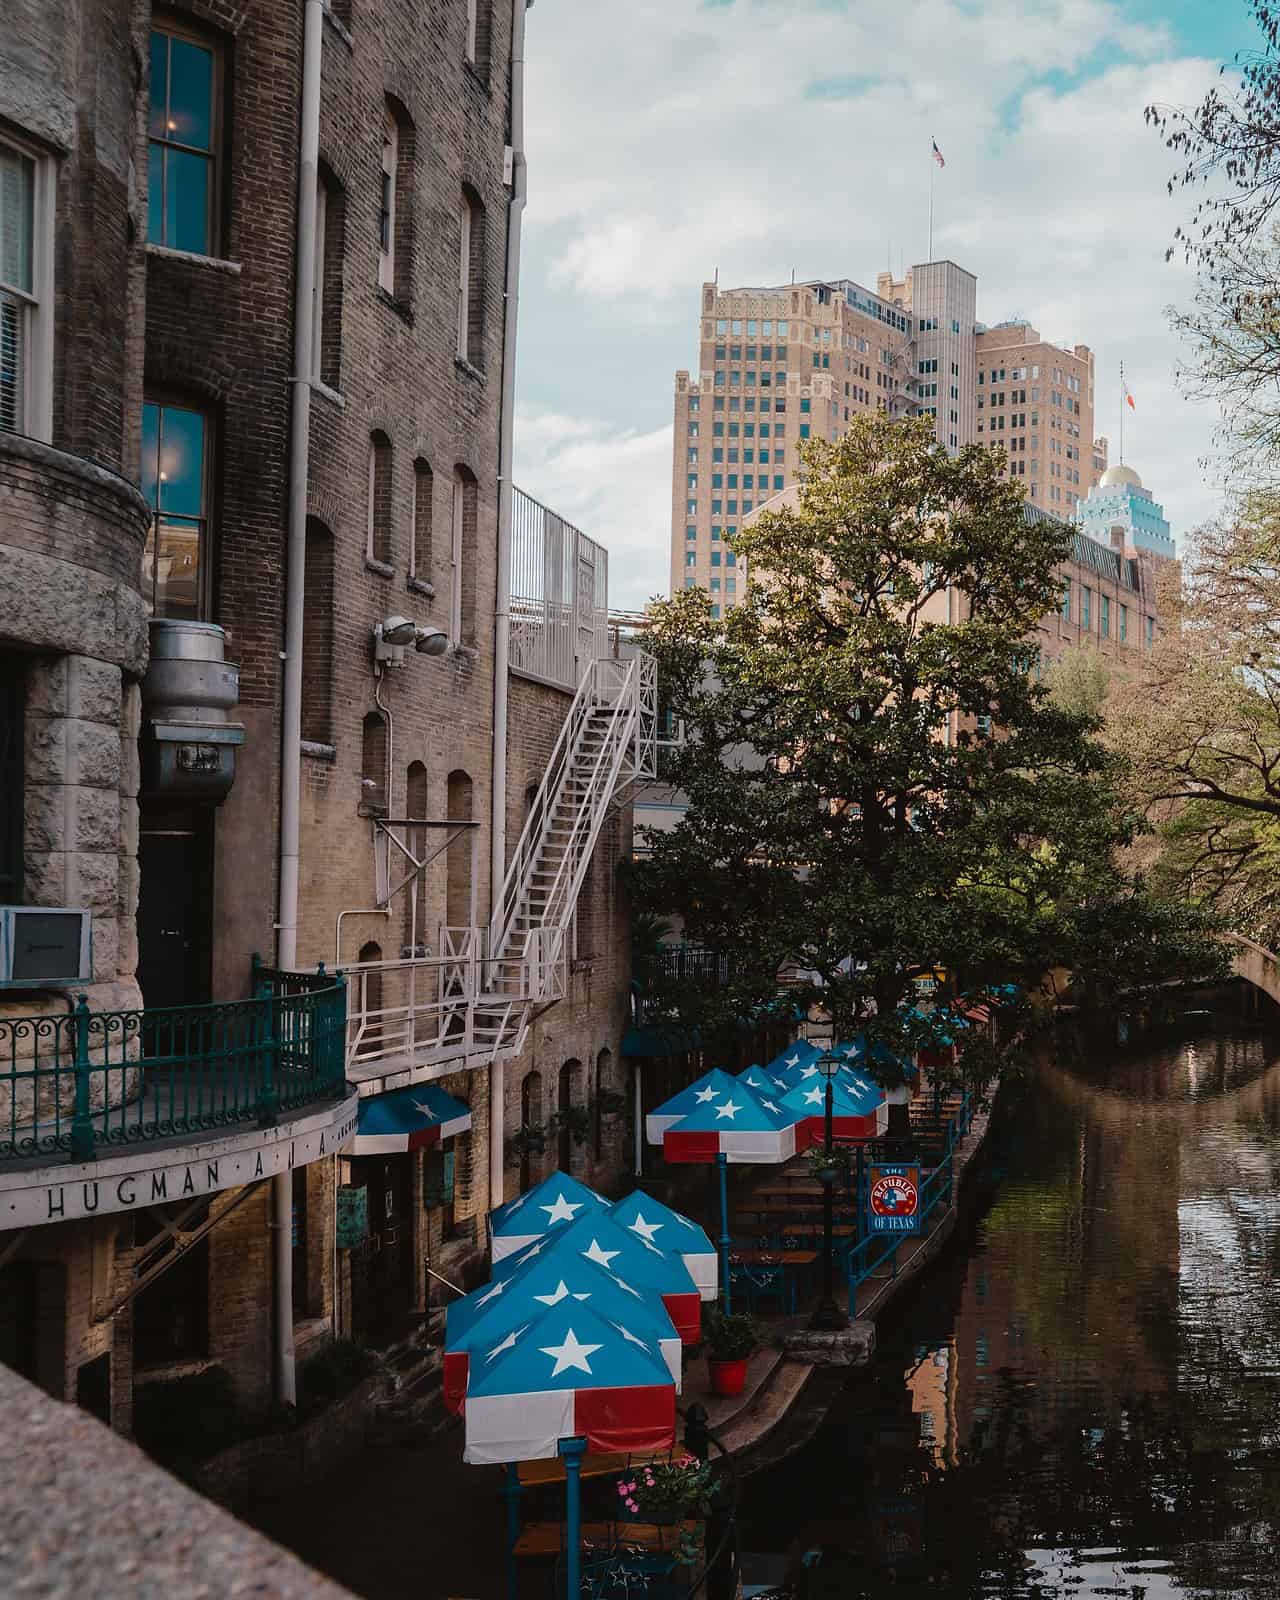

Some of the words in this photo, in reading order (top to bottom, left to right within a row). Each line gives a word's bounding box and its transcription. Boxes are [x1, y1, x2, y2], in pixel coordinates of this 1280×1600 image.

[47, 1160, 218, 1218] HUGMAN
[873, 1178, 914, 1198] REPUBLIC
[874, 1216, 885, 1229] OF
[888, 1216, 914, 1230] TEXAS
